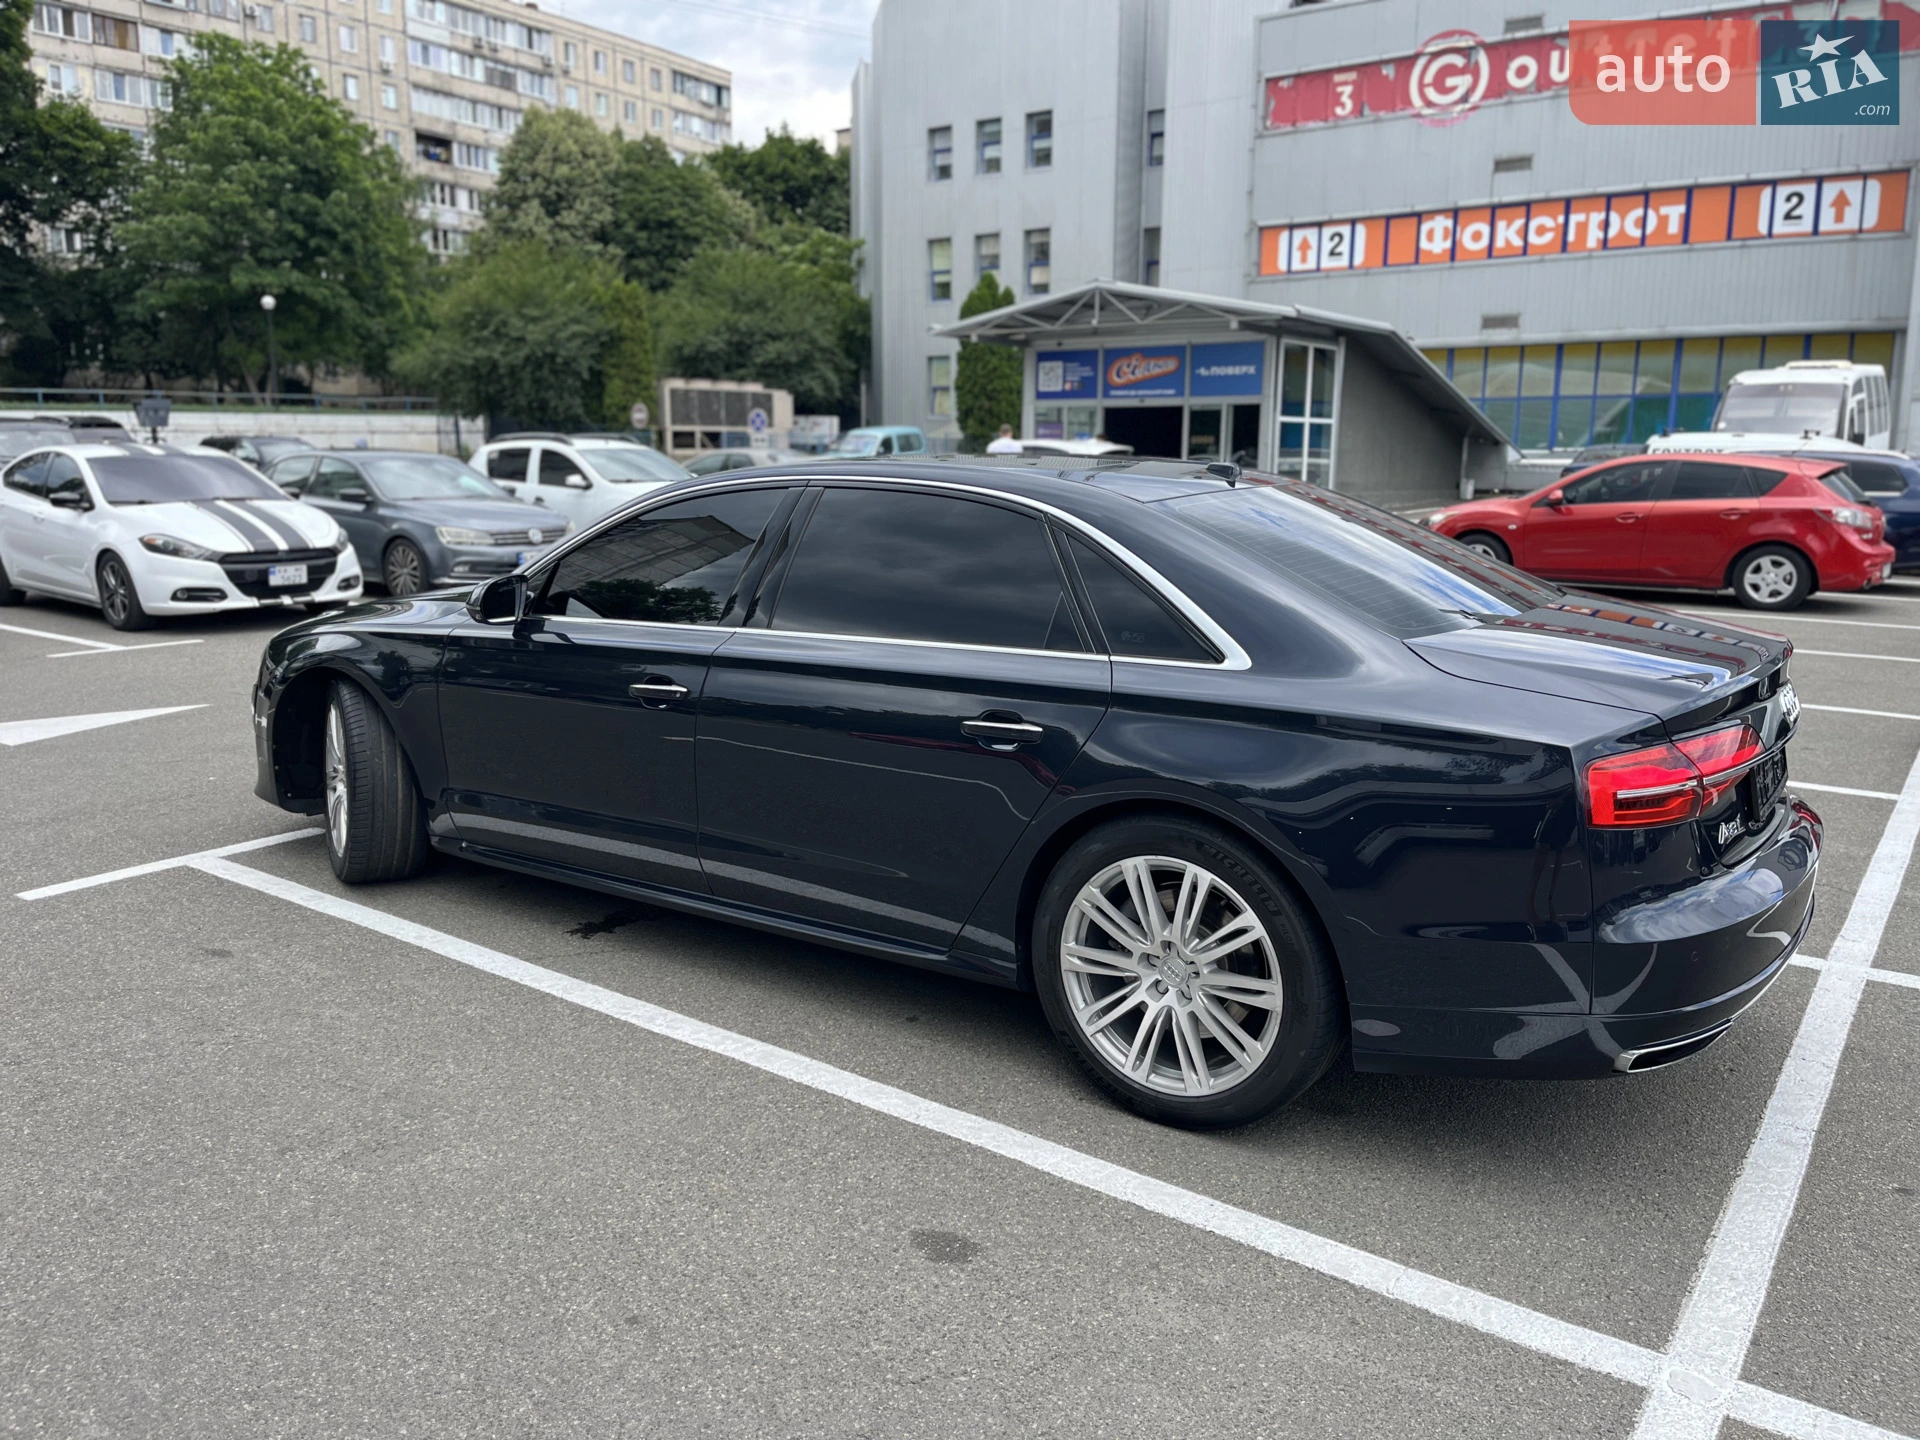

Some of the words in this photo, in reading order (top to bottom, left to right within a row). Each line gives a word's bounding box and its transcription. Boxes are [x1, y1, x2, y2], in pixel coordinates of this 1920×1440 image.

[1333, 84, 1355, 117] 3
[1328, 231, 1345, 258] 2
[1418, 204, 1687, 255] Фокстрот
[1782, 190, 1806, 221] 2
